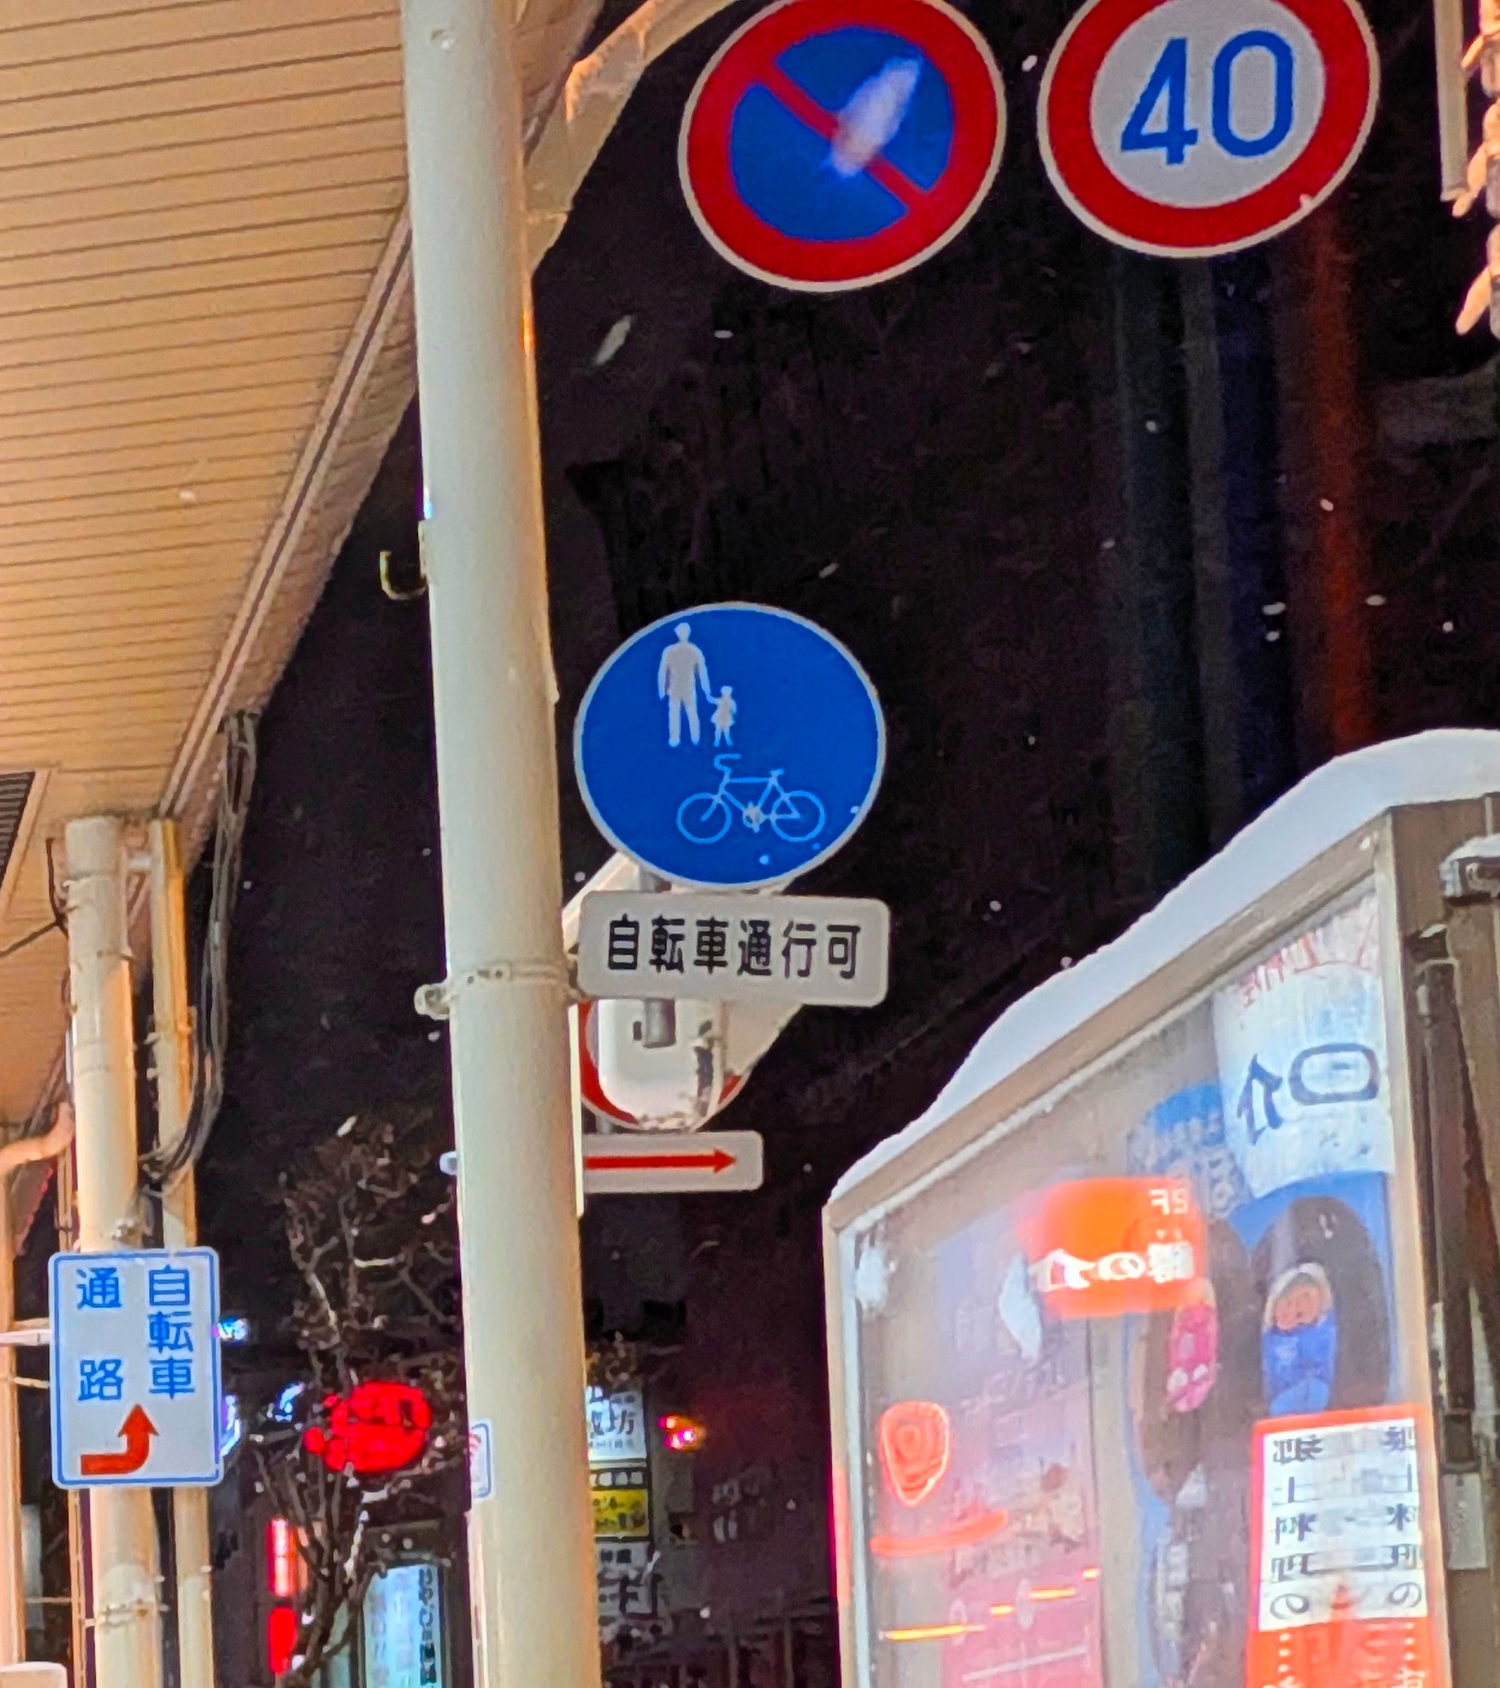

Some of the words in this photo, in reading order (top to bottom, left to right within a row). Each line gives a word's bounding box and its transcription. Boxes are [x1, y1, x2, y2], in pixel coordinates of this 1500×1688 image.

[1121, 29, 1294, 166] 40
[605, 913, 861, 979] 自転車通行可
[76, 1269, 123, 1403] 通路
[148, 1265, 195, 1400] 自転車
